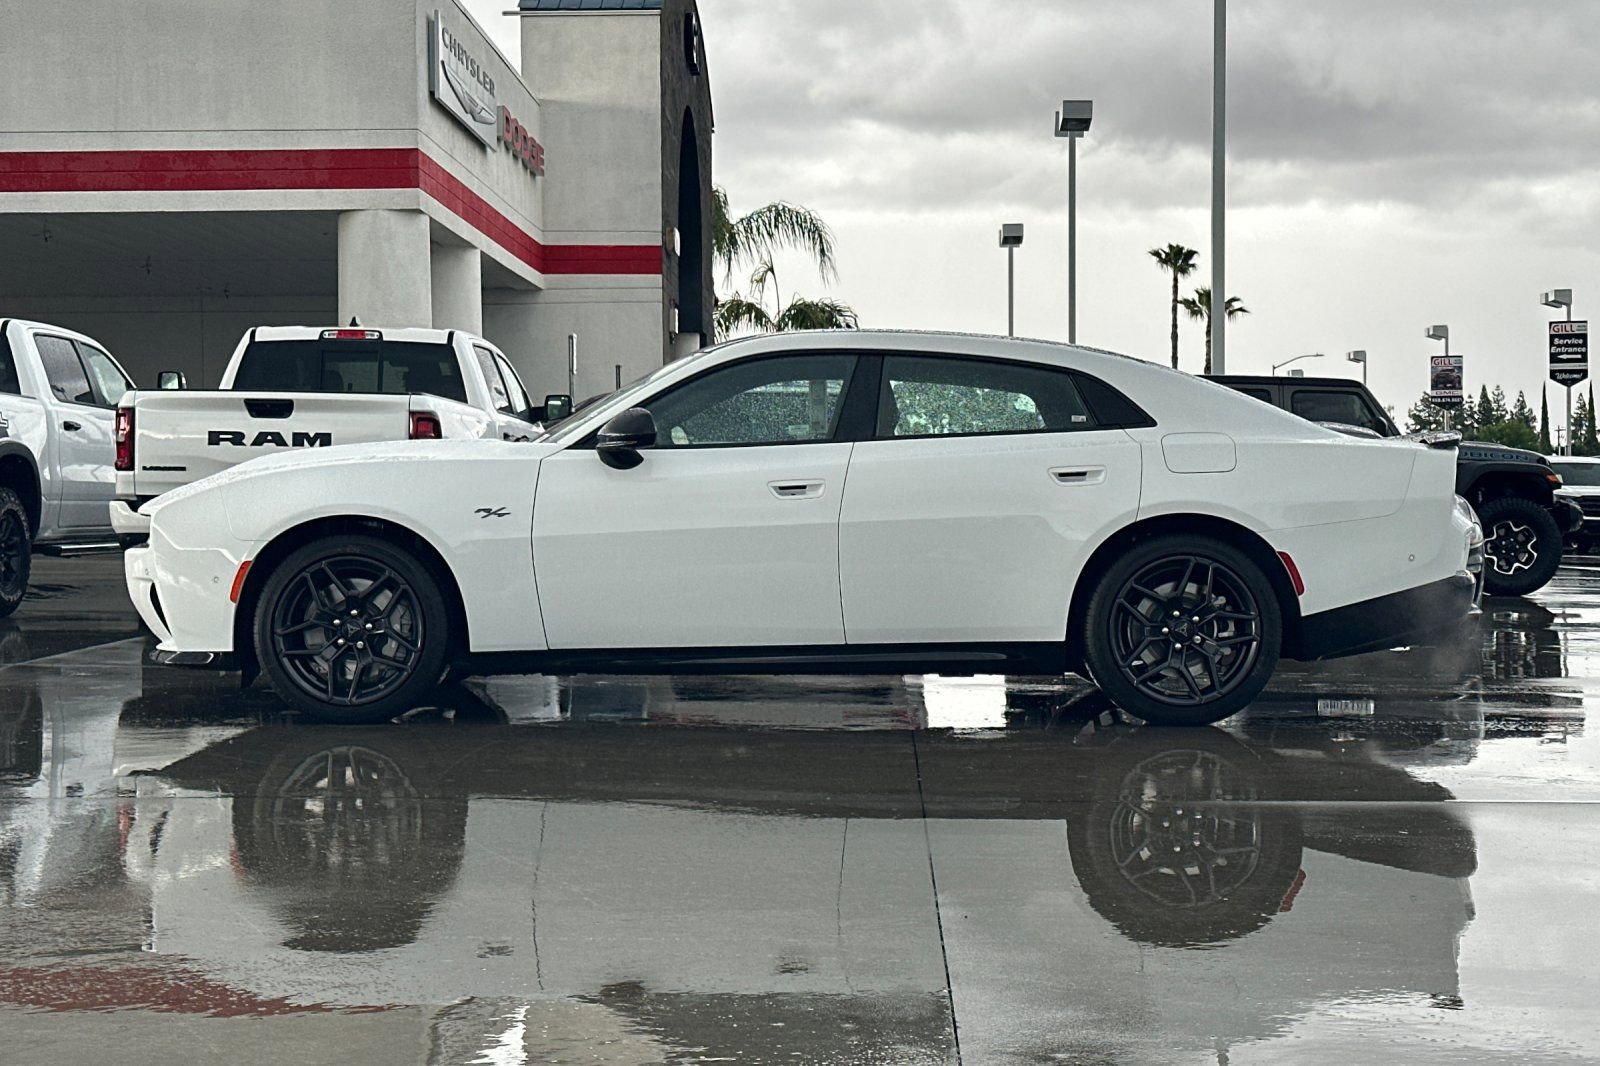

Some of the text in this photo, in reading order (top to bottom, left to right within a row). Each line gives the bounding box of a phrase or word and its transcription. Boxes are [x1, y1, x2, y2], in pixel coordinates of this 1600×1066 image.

[442, 27, 495, 98] CHRYSLER
[497, 105, 545, 177] DODGE
[1552, 324, 1576, 334] GILL
[1433, 358, 1453, 366] GILL
[208, 430, 332, 448] RAM
[1460, 450, 1529, 461] UBICON
